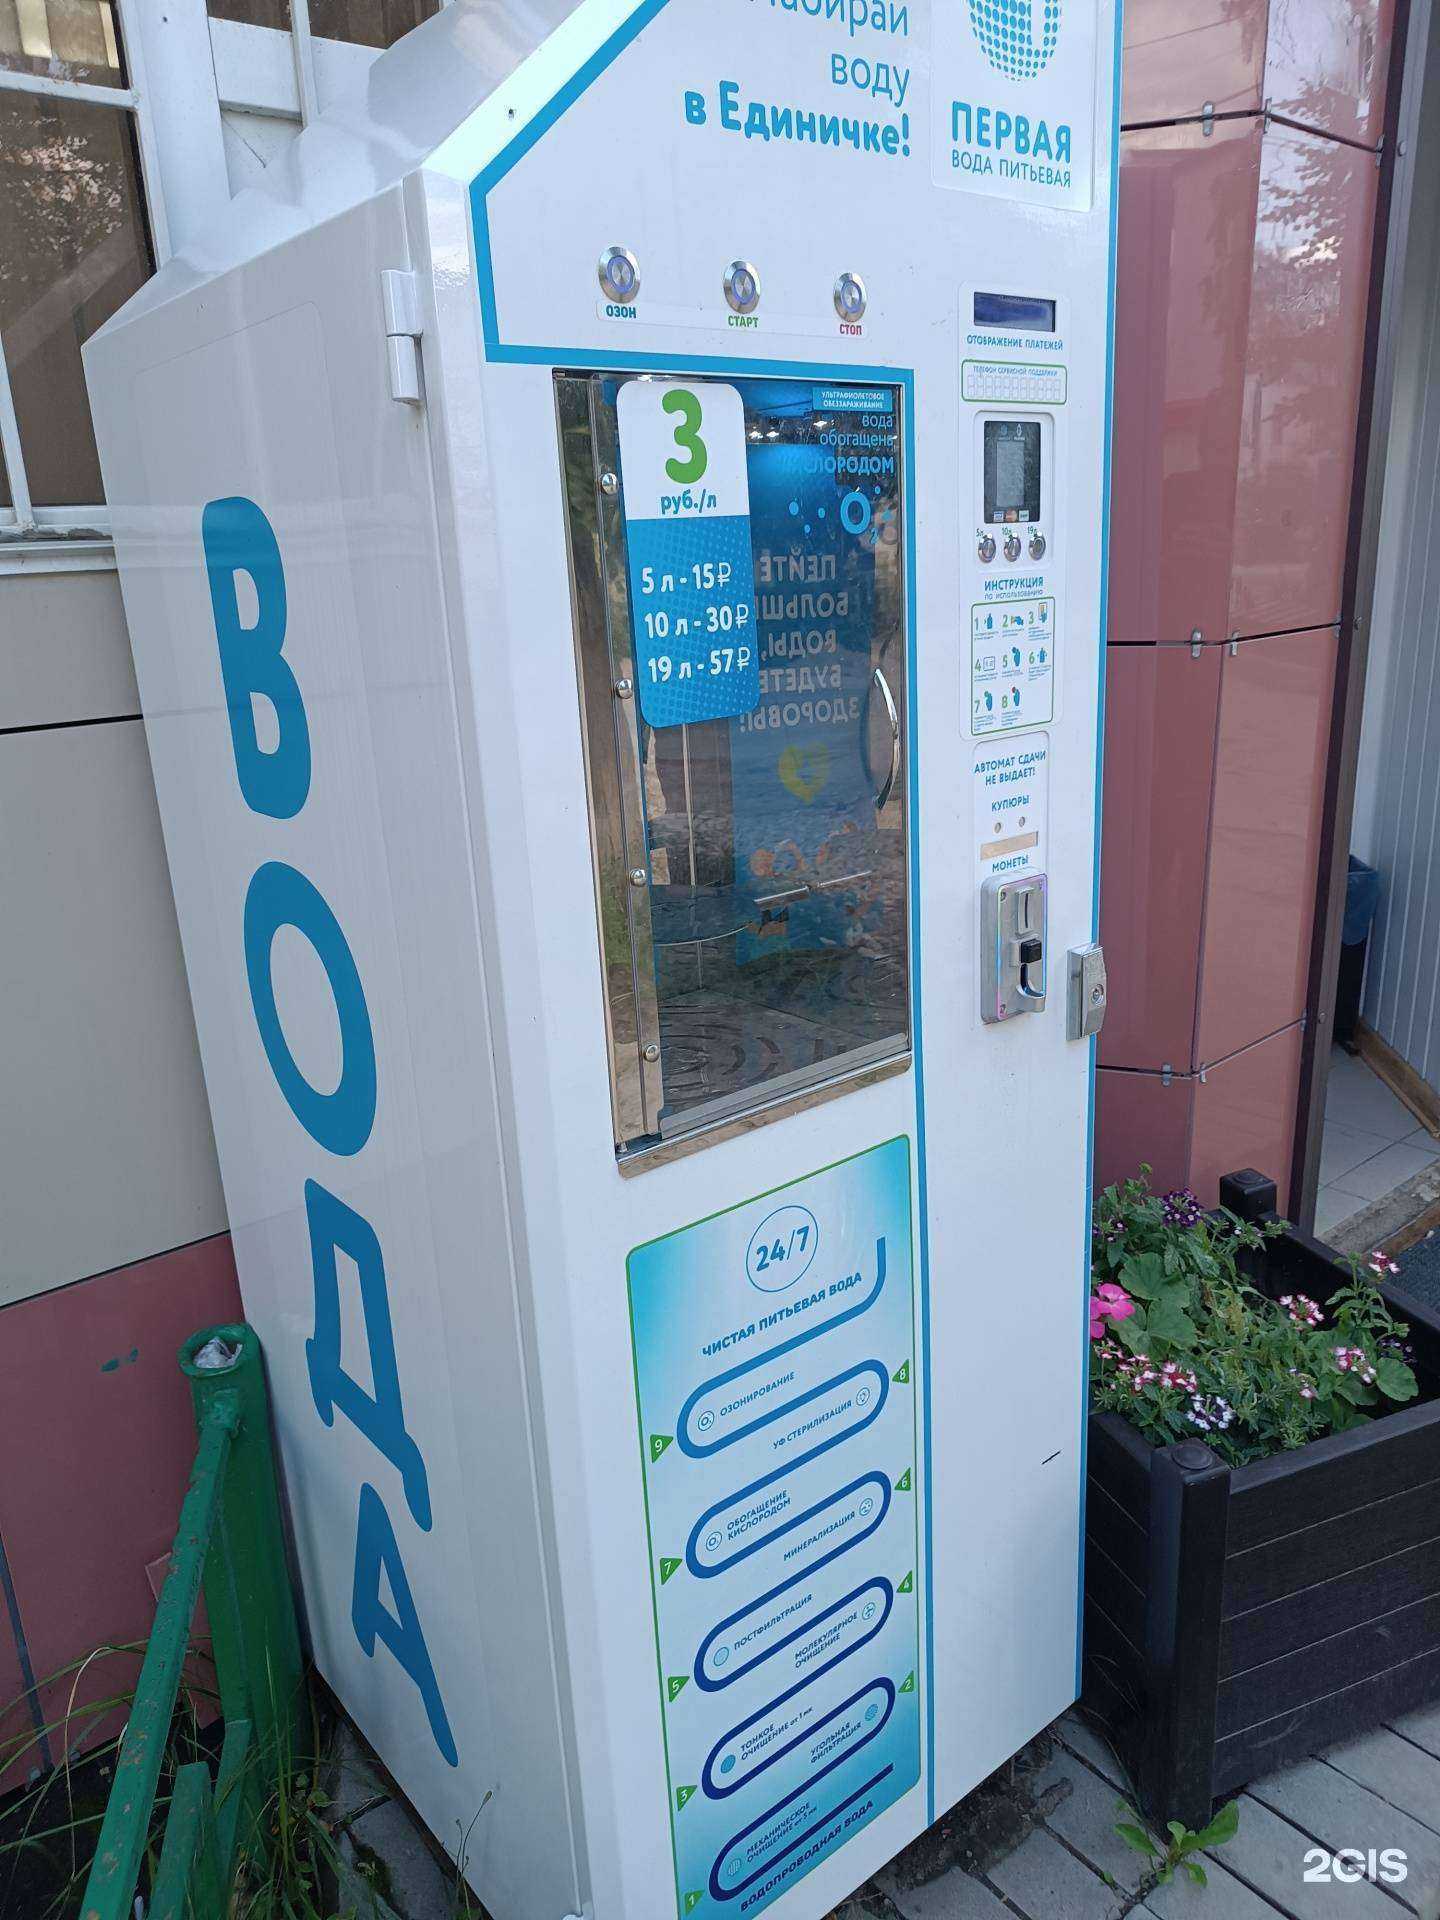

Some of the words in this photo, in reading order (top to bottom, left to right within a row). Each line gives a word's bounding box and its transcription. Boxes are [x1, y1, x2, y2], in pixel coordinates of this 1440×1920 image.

[831, 53, 910, 107] воду
[684, 90, 707, 125] в
[719, 79, 911, 157] Единичке!
[952, 101, 1071, 163] ПЕРВАЯ
[952, 149, 993, 175] ВОДА
[999, 158, 1071, 188] ПИТЬЕВАЯ
[605, 305, 637, 319] ОЗОН
[728, 315, 759, 328] СТАРТ
[839, 323, 862, 336] СТОП
[966, 334, 1023, 348] ОТОБРАЖЕНИЕ
[1025, 339, 1064, 351] ПЛАТЕЖЕЙ
[823, 399, 883, 409] ОБЕЗЗАРАЖИВАНИЕ
[862, 415, 893, 430] вода
[661, 388, 708, 485] 3
[819, 429, 894, 448] обогащена
[660, 489, 717, 515] руб./л
[641, 567, 655, 594] 5
[984, 576, 1044, 591] ИНСТРУКЦИЯ
[644, 611, 670, 639] 10
[1002, 614, 1008, 628] 2
[1028, 611, 1034, 624] 3
[648, 655, 672, 684] 19
[974, 658, 981, 672] 4
[1002, 654, 1008, 668] 5
[1029, 651, 1035, 664] 6
[974, 699, 980, 713] 7
[1002, 695, 1008, 708] 8
[974, 756, 1016, 774] АВТОМАТ
[1018, 750, 1047, 765] СДАЧИ
[985, 775, 997, 786] НЕ
[1000, 767, 1036, 783] ВЫДАЕТ!
[991, 794, 1030, 812] КУПЮРЫ
[992, 855, 1029, 873] МОНЕТЫ
[202, 496, 459, 1768] ВОДА
[756, 1225, 810, 1272] 24/7
[702, 1322, 755, 1356] ЧИСТАЯ
[758, 1289, 826, 1331] ПИТЬЕВАЯ
[829, 1272, 862, 1297] ВОДА
[899, 1368, 906, 1380] 8
[720, 1371, 795, 1417] ОЗОНИРОВАНИЕ
[772, 1437, 786, 1450] УФ
[786, 1400, 852, 1442] СТЕРИЛИЗАЦИЯ
[654, 1439, 663, 1453] 9
[727, 1490, 788, 1531] ОБОГАЩЕНИЕ
[728, 1498, 791, 1541] КИСЛОРОДОМ
[783, 1511, 856, 1562] МИНЕРАЛИЗАЦИЯ
[664, 1561, 672, 1575] 7
[734, 1593, 813, 1650] ПОСТФИЛЬТРАЦИЯ
[795, 1611, 858, 1660] МОЛЕКУЛЯРНОЕ
[795, 1632, 841, 1668] ОЧИЩЕНИЕ
[672, 1680, 680, 1693] 5
[905, 1679, 912, 1690] 2
[740, 1723, 775, 1751] ТОНКОЕ
[741, 1722, 789, 1760] ОЧИЩЕНИЕ
[810, 1722, 851, 1756] УГОЛЬНАЯ
[810, 1721, 862, 1763] ФИЛЬТРАЦИЯ
[681, 1788, 688, 1799] 3
[746, 1802, 810, 1855] МЕХАНИЧЕСКОЕ
[740, 1823, 842, 1912] ВОДОПРОВОДНАЯ
[844, 1800, 874, 1827] ВОДА
[747, 1823, 793, 1863] ОЧИЩЕНИЕ
[687, 1894, 695, 1906] 1
